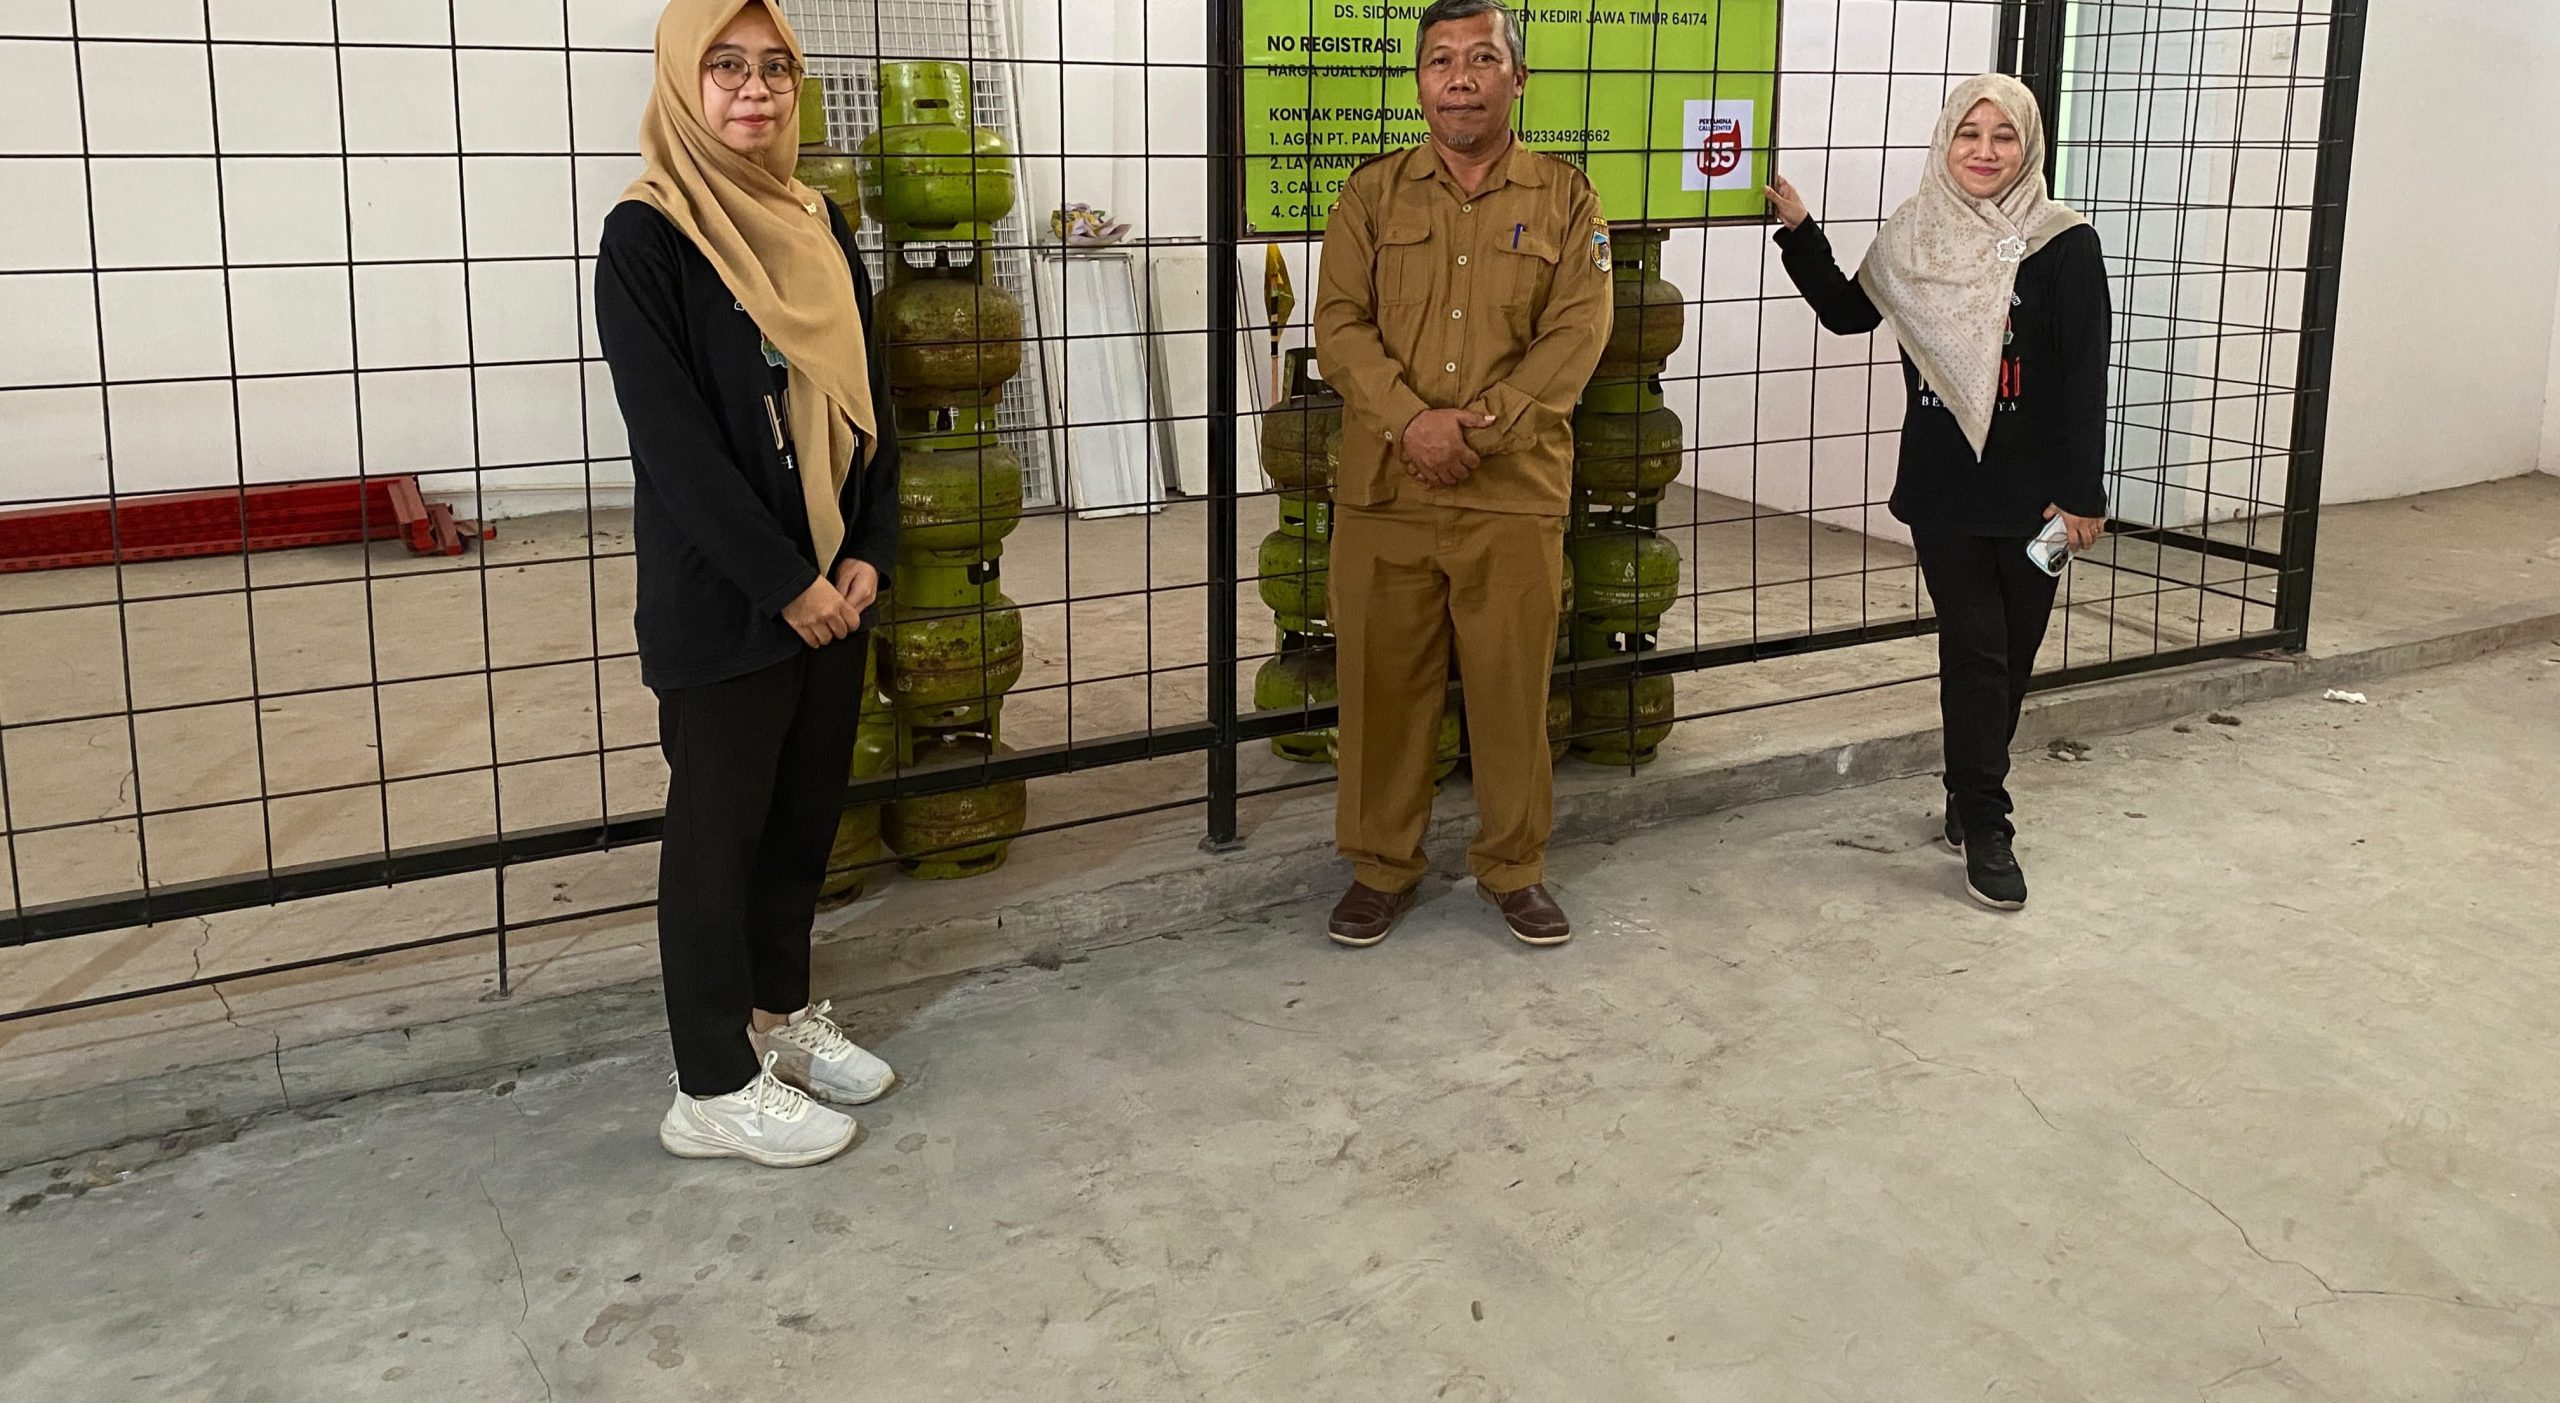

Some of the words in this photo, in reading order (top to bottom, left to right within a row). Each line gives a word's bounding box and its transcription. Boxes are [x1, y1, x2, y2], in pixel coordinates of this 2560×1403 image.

[1334, 5, 1358, 18] DS.
[1540, 10, 1582, 23] KEDIRI
[1586, 11, 1625, 24] JAWA
[1629, 12, 1668, 25] TIMUR
[1672, 13, 1708, 25] 64174
[1267, 36, 1295, 51] NO
[1301, 37, 1402, 53] REGISTRASI
[1268, 64, 1318, 77] HARGA
[1322, 65, 1357, 77] JUAL
[1269, 108, 1331, 121] KONTAK
[1336, 108, 1425, 121] PENGADUAN
[1270, 132, 1278, 145] 1.
[1283, 132, 1323, 146] AGEN
[1328, 132, 1348, 145] PT.
[1352, 132, 1431, 145] PAMENANG
[1270, 157, 1282, 170] 2.
[1287, 156, 1354, 169] LAYANAN
[1271, 181, 1283, 194] 3.
[1287, 181, 1322, 193] CALL
[1271, 205, 1284, 218] 4.
[1288, 205, 1324, 217] CALL
